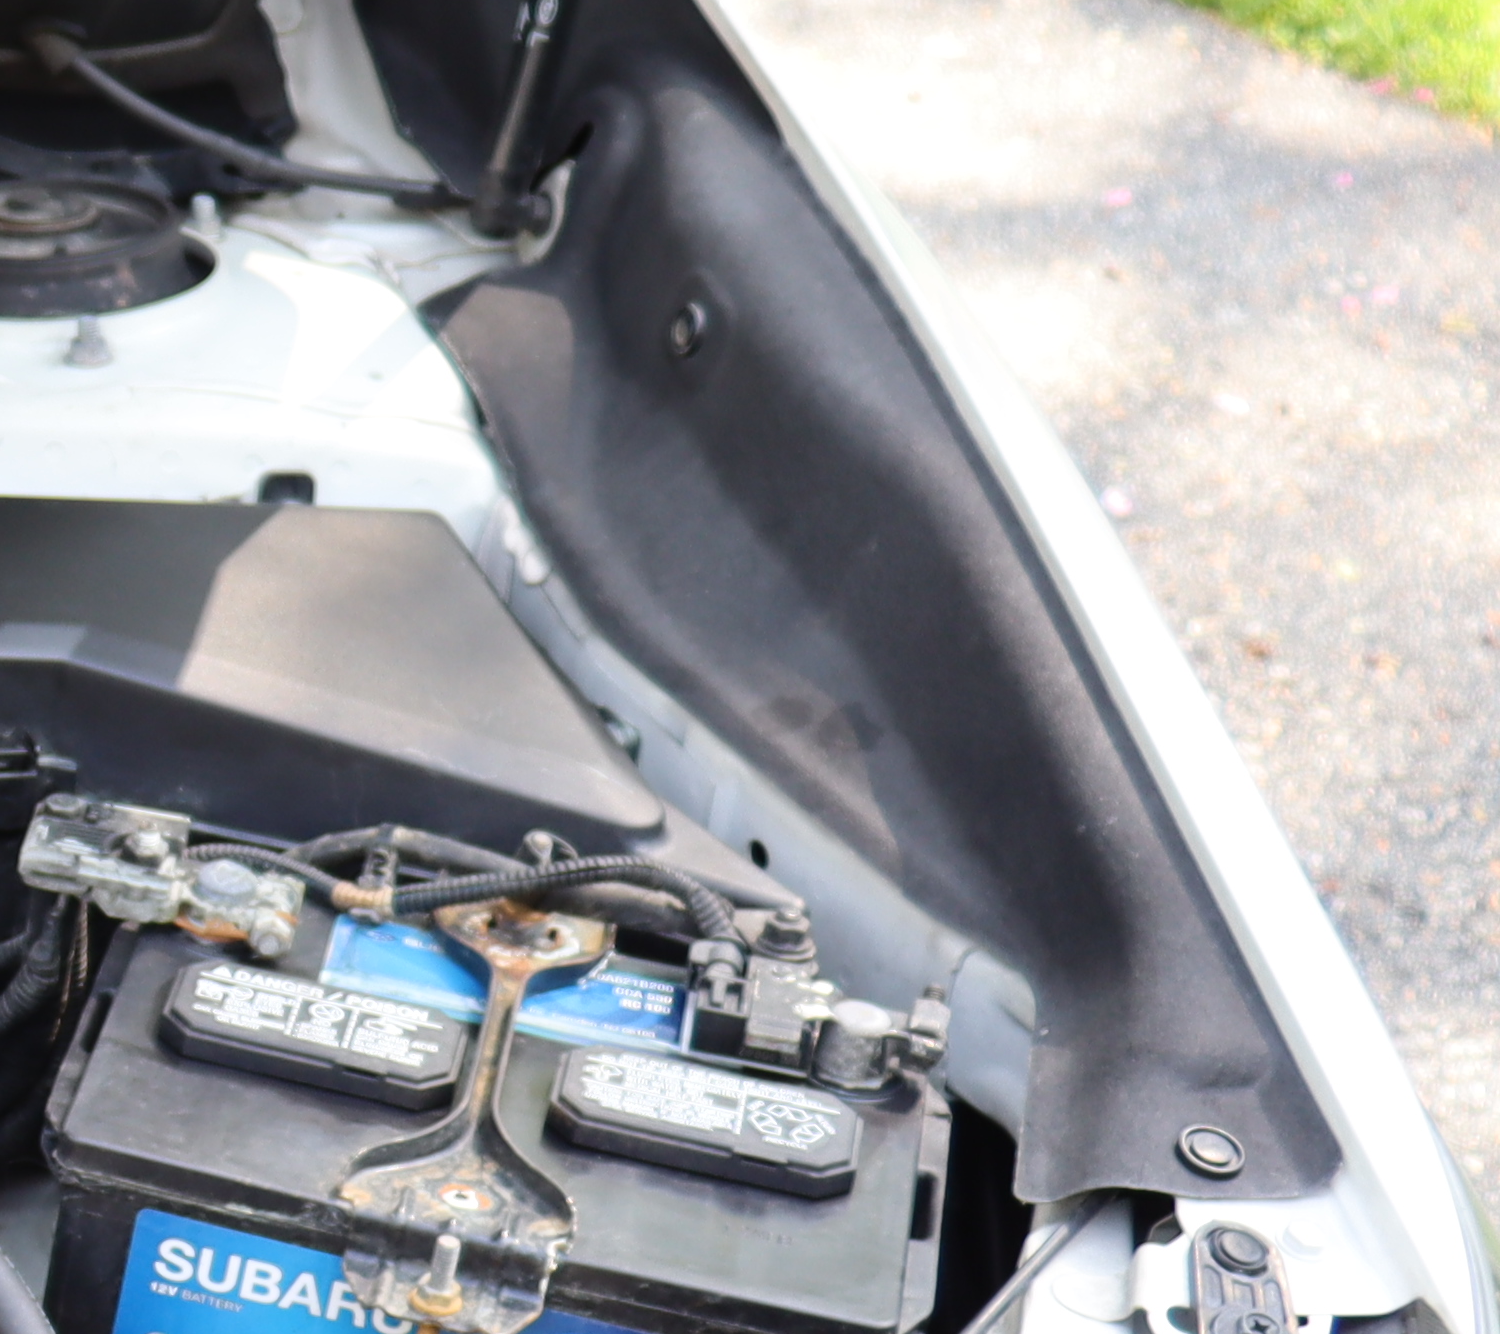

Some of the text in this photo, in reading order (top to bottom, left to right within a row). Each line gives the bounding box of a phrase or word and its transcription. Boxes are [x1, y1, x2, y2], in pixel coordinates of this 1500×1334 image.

[235, 969, 324, 999] DANGER
[345, 993, 429, 1023] POISON
[150, 1281, 243, 1313] 12V BATTERY
